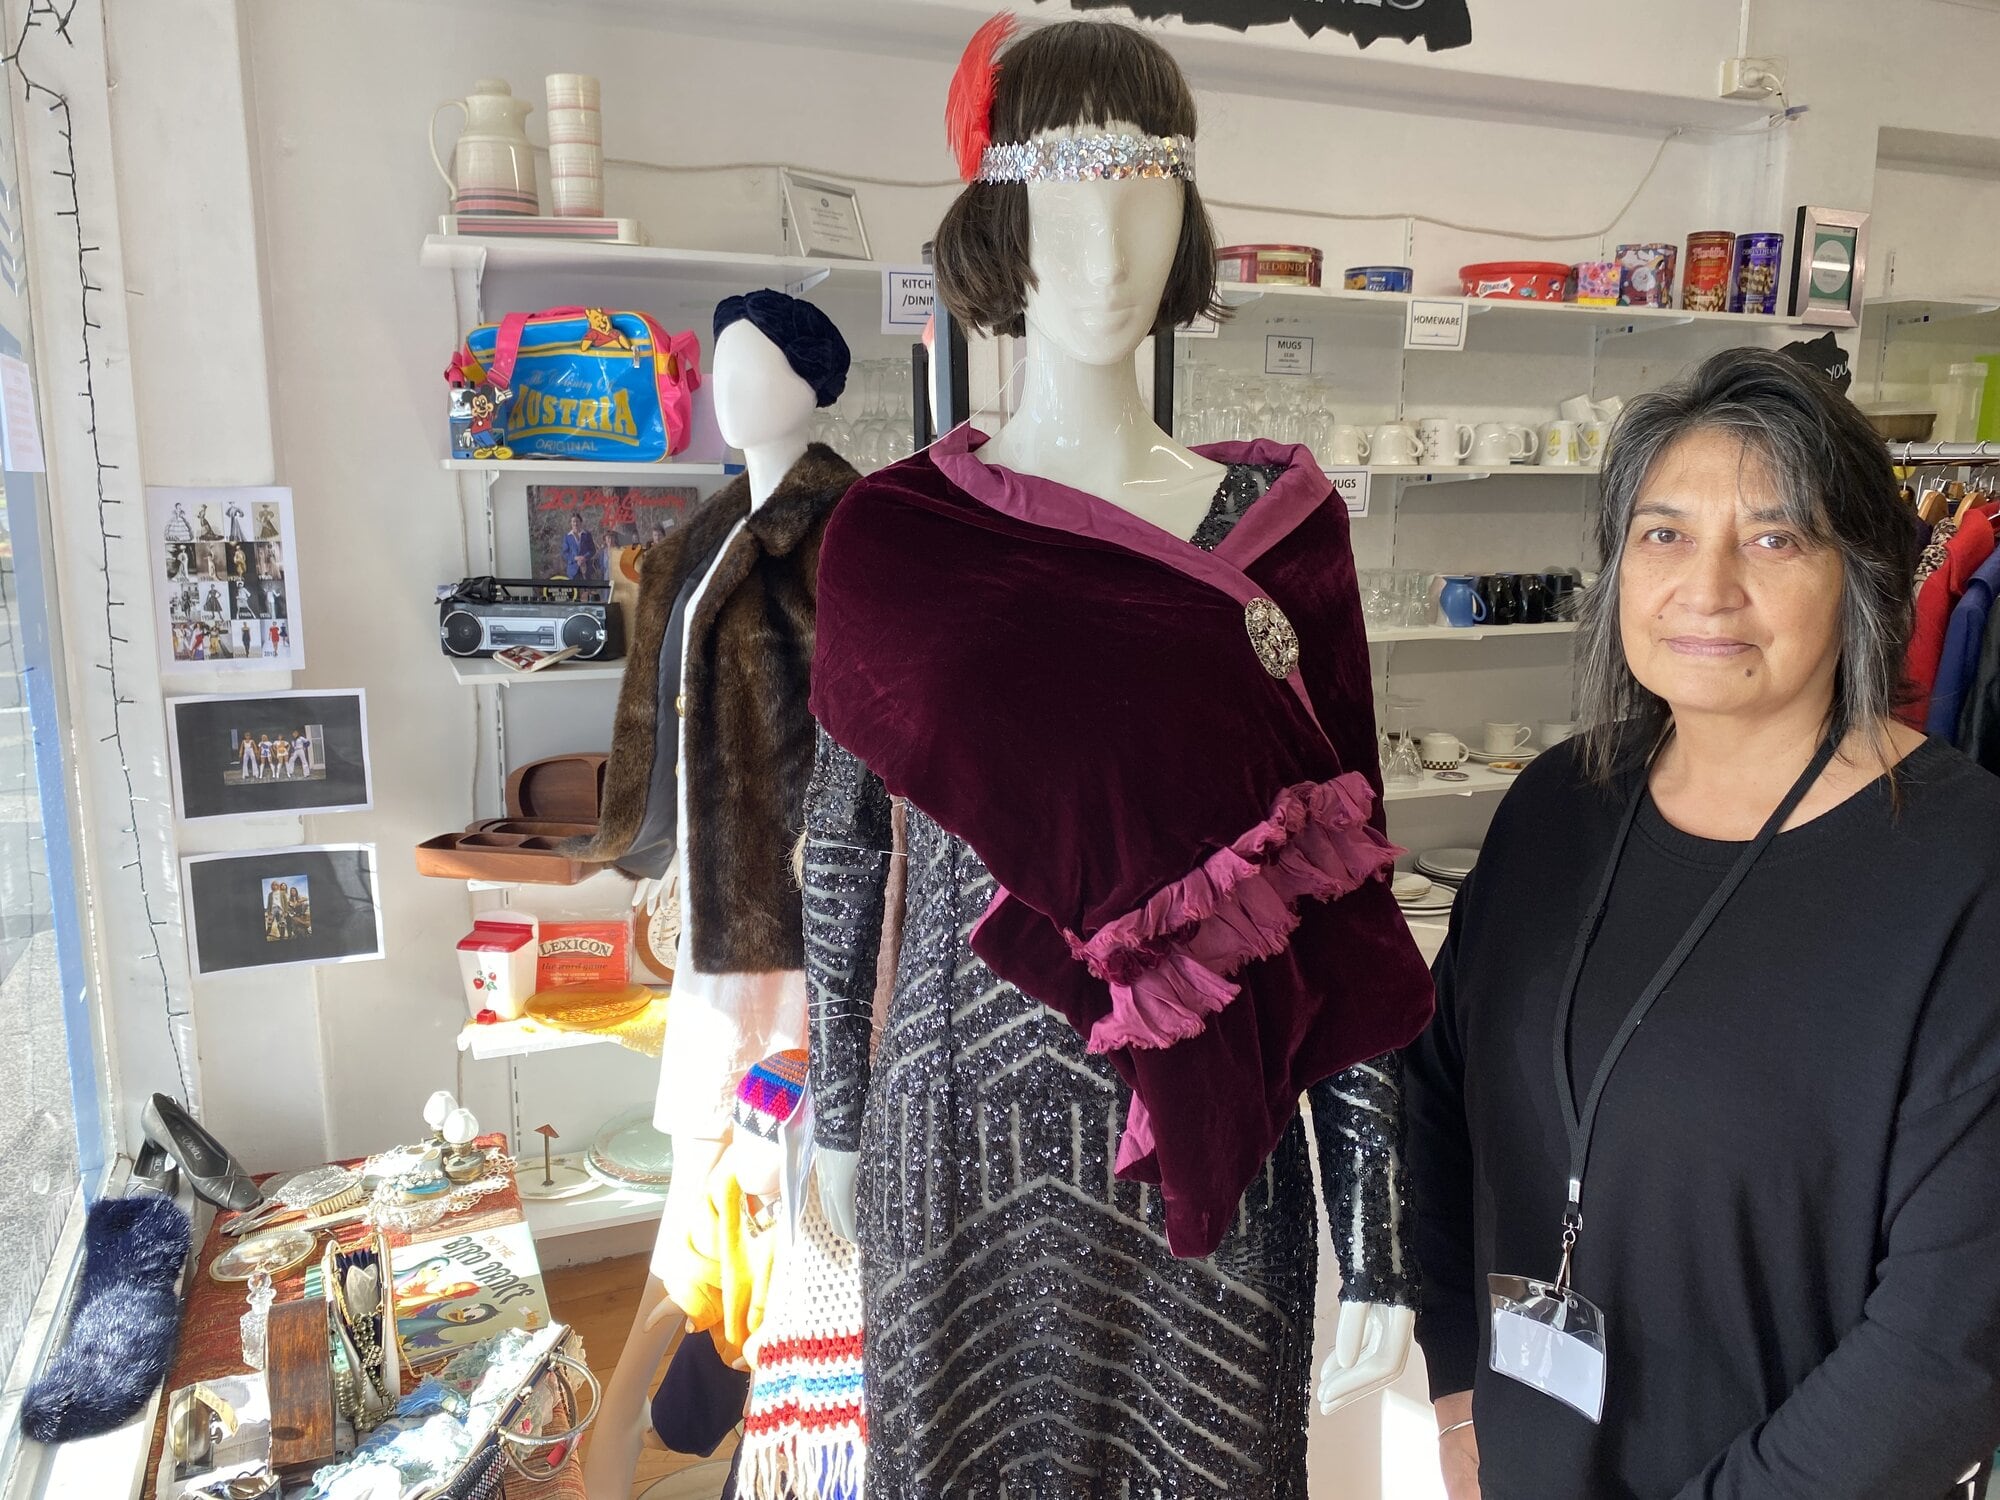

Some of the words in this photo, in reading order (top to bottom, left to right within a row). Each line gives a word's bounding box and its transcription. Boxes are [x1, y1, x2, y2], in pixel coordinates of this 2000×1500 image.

[1259, 262, 1307, 273] REDONDO
[902, 278, 932, 289] KITCH
[902, 294, 935, 307] /DININ
[1413, 315, 1460, 326] HOMEWARE
[1277, 340, 1302, 350] MUGS
[507, 384, 638, 437] AUSTRIA
[535, 438, 598, 453] ORIGINAL
[538, 487, 578, 511] 20
[539, 939, 610, 956] LEXICON
[441, 1236, 492, 1267] BIRD
[472, 1261, 535, 1305] DANCE
